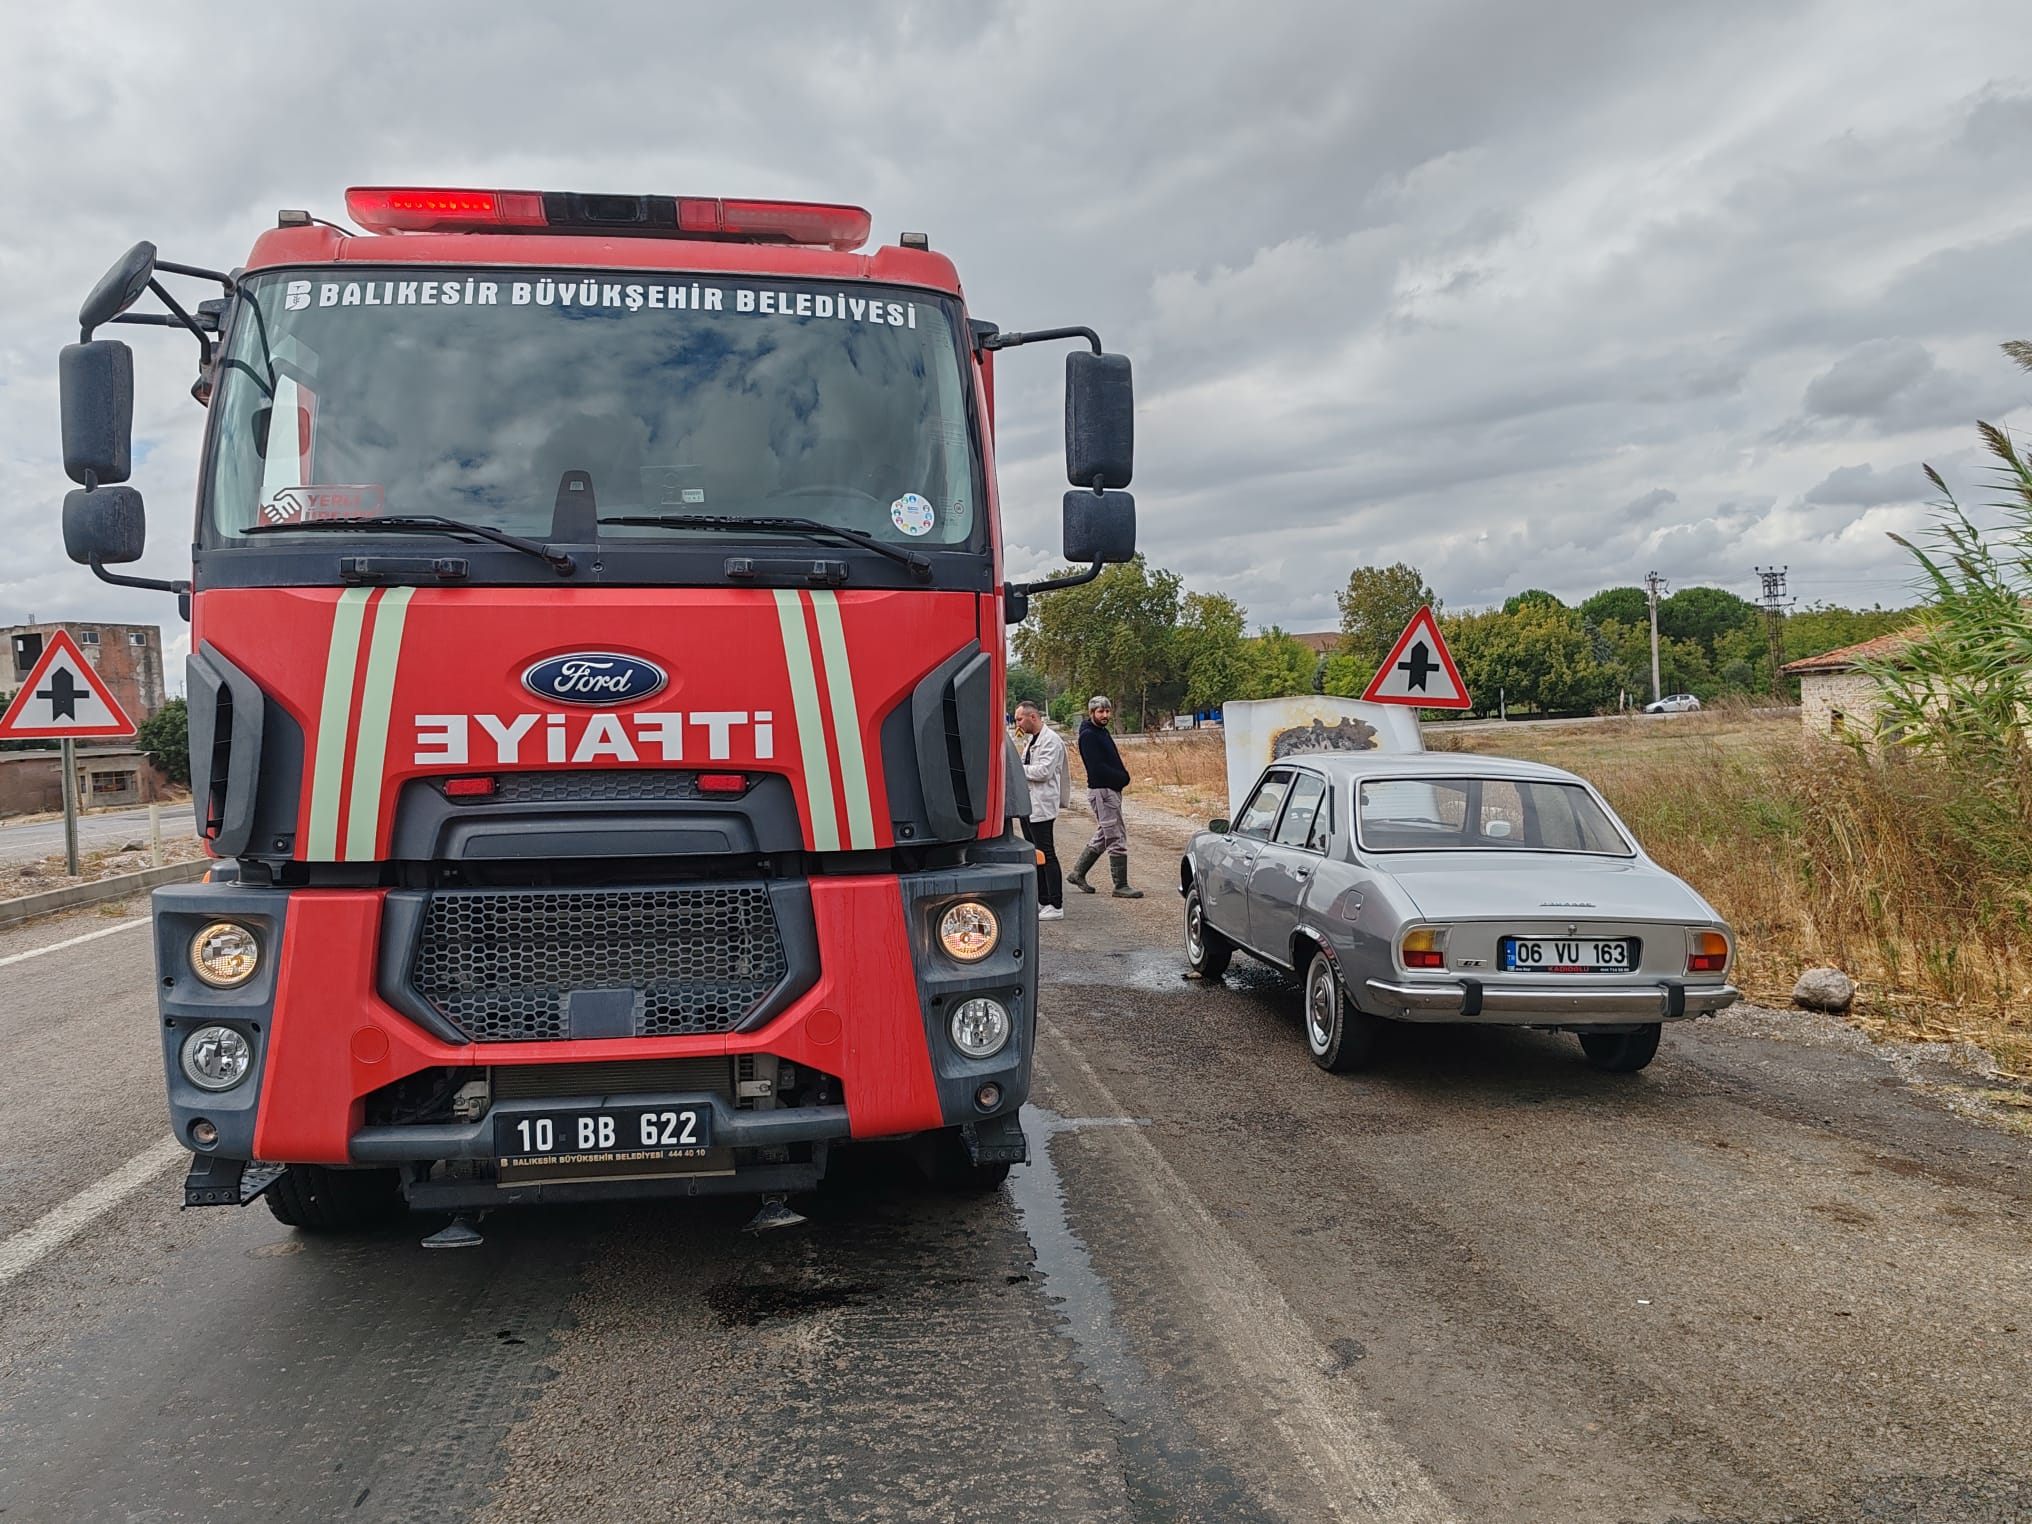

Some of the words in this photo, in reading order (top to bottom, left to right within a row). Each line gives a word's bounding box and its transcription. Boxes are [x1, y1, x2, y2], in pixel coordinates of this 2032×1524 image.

[319, 278, 497, 307] BALIKESİR
[512, 278, 723, 312] BÜYÜKŞEHİR
[737, 290, 916, 329] BELEDİYESİ
[553, 661, 634, 692] Ford
[1518, 943, 1542, 963] 06
[1554, 943, 1579, 963] VU
[1593, 943, 1626, 964] 163
[517, 1119, 553, 1151] 10
[578, 1116, 616, 1149] BB
[640, 1111, 697, 1146] 622
[668, 1150, 683, 1158] 444
[684, 1150, 694, 1158] 40
[696, 1149, 706, 1157] 10
